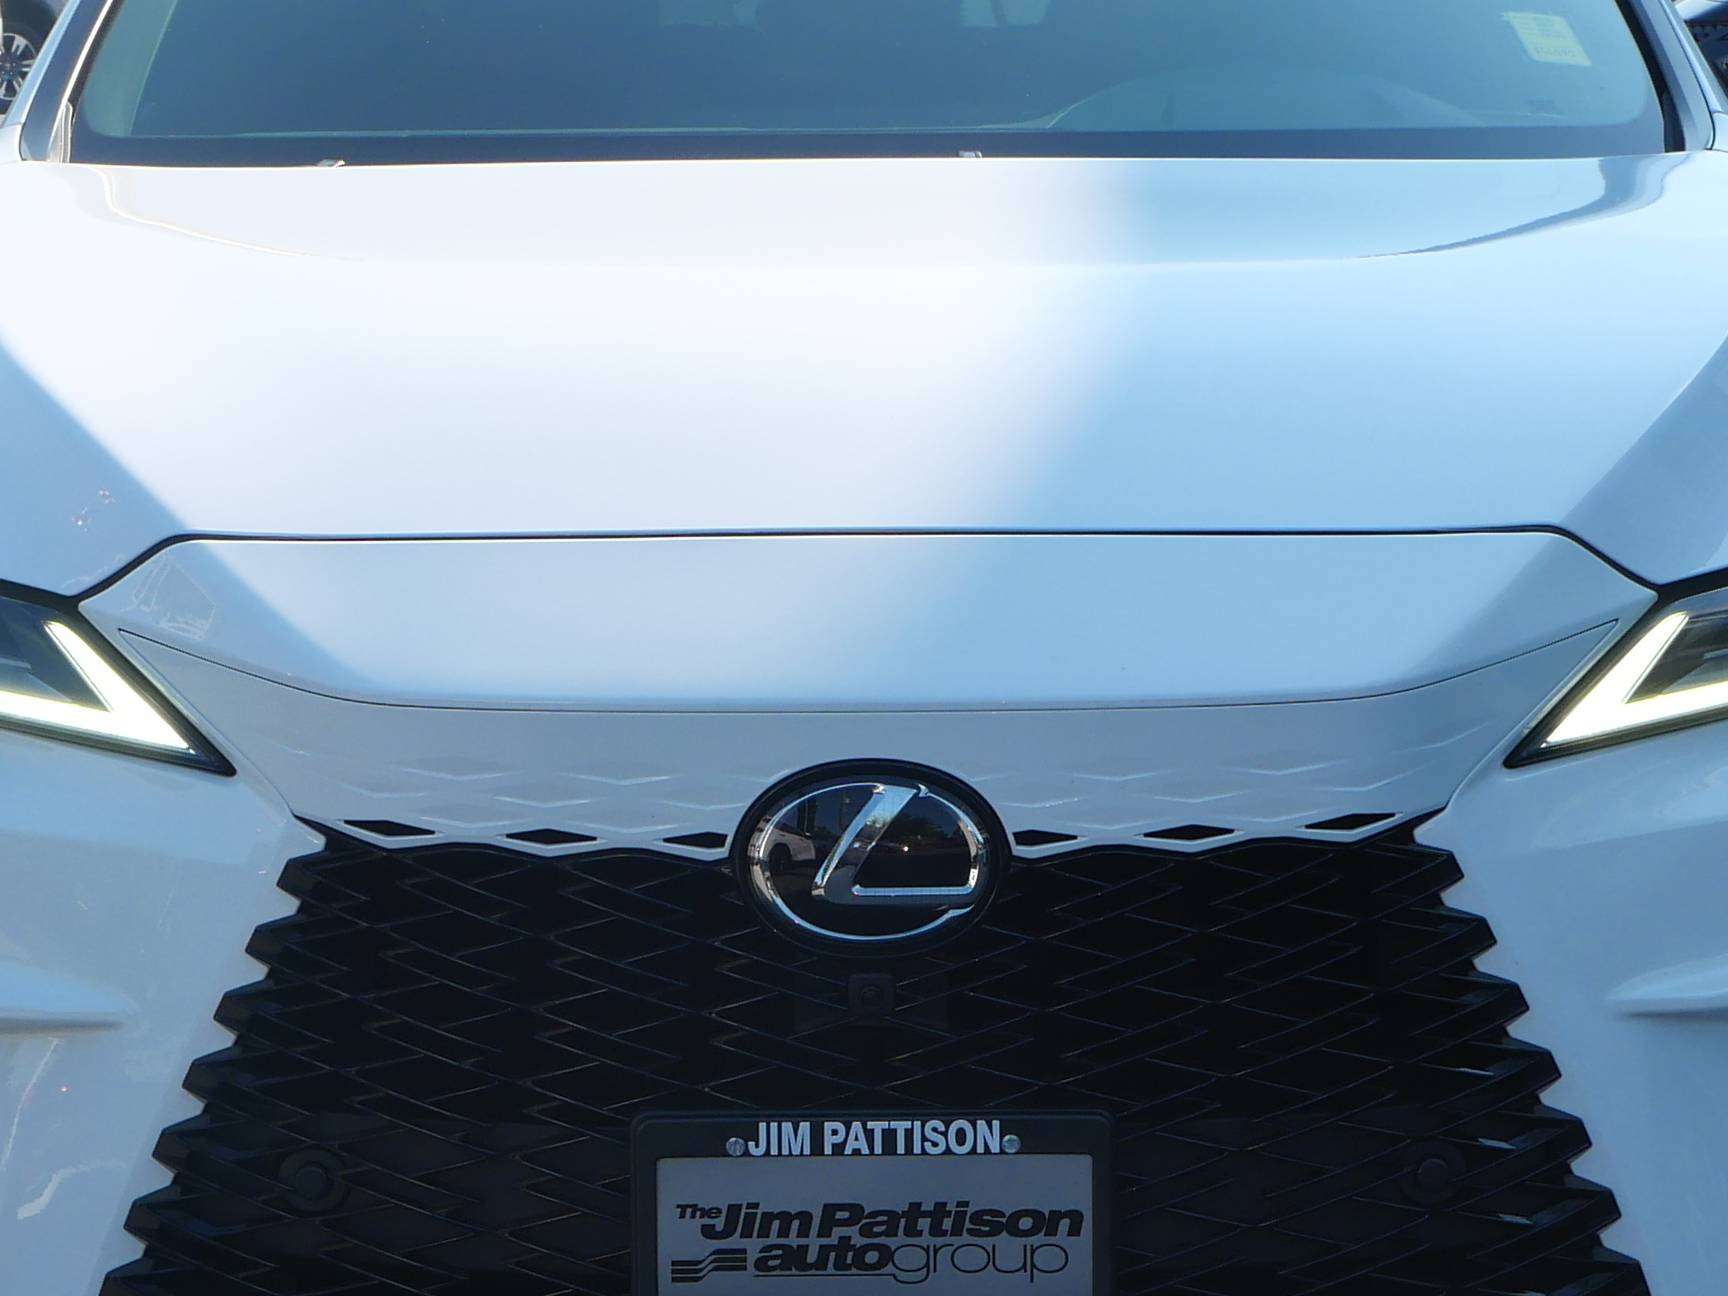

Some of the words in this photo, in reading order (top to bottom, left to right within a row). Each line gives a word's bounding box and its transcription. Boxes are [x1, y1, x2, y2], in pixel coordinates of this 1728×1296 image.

[747, 1121, 811, 1157] JIM
[824, 1119, 1001, 1156] PATTISON
[675, 1203, 723, 1220] The
